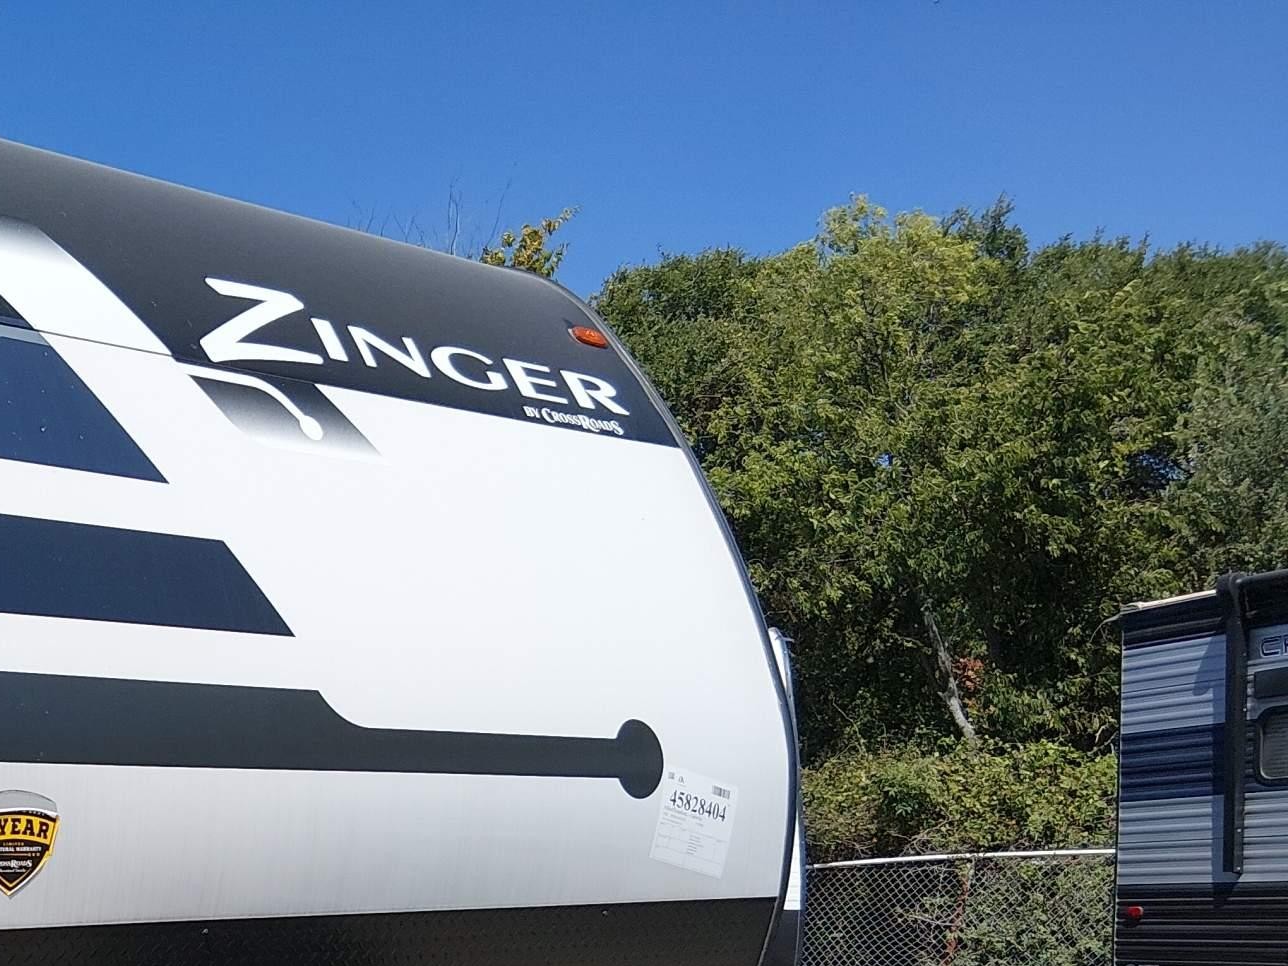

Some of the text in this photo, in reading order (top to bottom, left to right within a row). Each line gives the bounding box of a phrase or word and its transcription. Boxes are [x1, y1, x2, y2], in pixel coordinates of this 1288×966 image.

[199, 277, 631, 416] ZINGER
[523, 406, 541, 419] BY
[669, 789, 727, 822] 45828404
